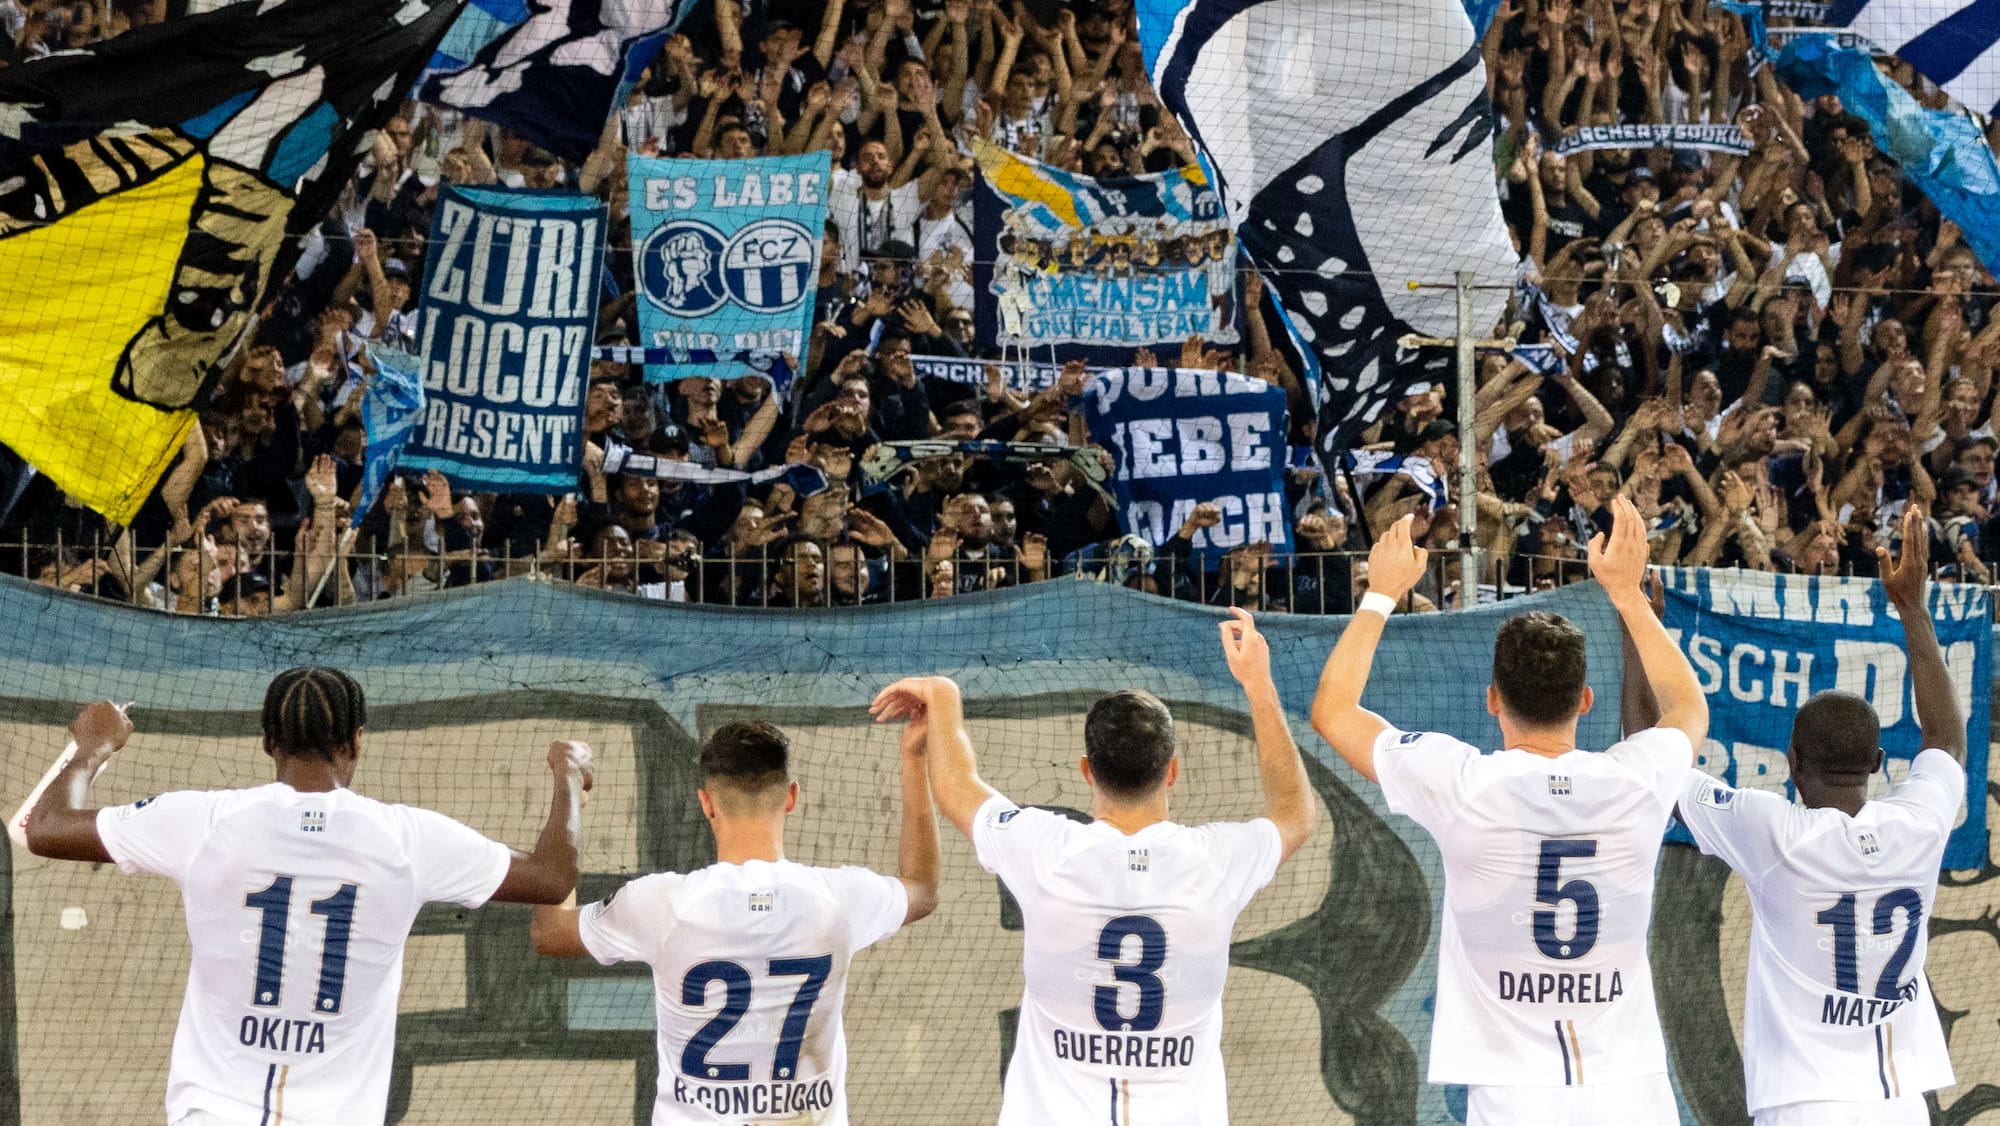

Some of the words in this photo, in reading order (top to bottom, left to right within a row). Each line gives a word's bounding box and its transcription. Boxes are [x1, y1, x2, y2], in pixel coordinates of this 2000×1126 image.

[645, 177, 697, 210] ES
[712, 165, 820, 208] LÄBE
[743, 236, 798, 262] FCZ
[420, 306, 587, 408] LOCOZ
[243, 874, 358, 1014] 11
[1532, 838, 1599, 961] 5
[1817, 886, 1921, 1000] 12
[680, 953, 833, 1082] 27
[1094, 914, 1168, 1032] 3
[1499, 967, 1625, 1004] DAPRELÀ
[239, 1015, 326, 1054] OKITA
[1053, 1029, 1195, 1068] GUERRERO
